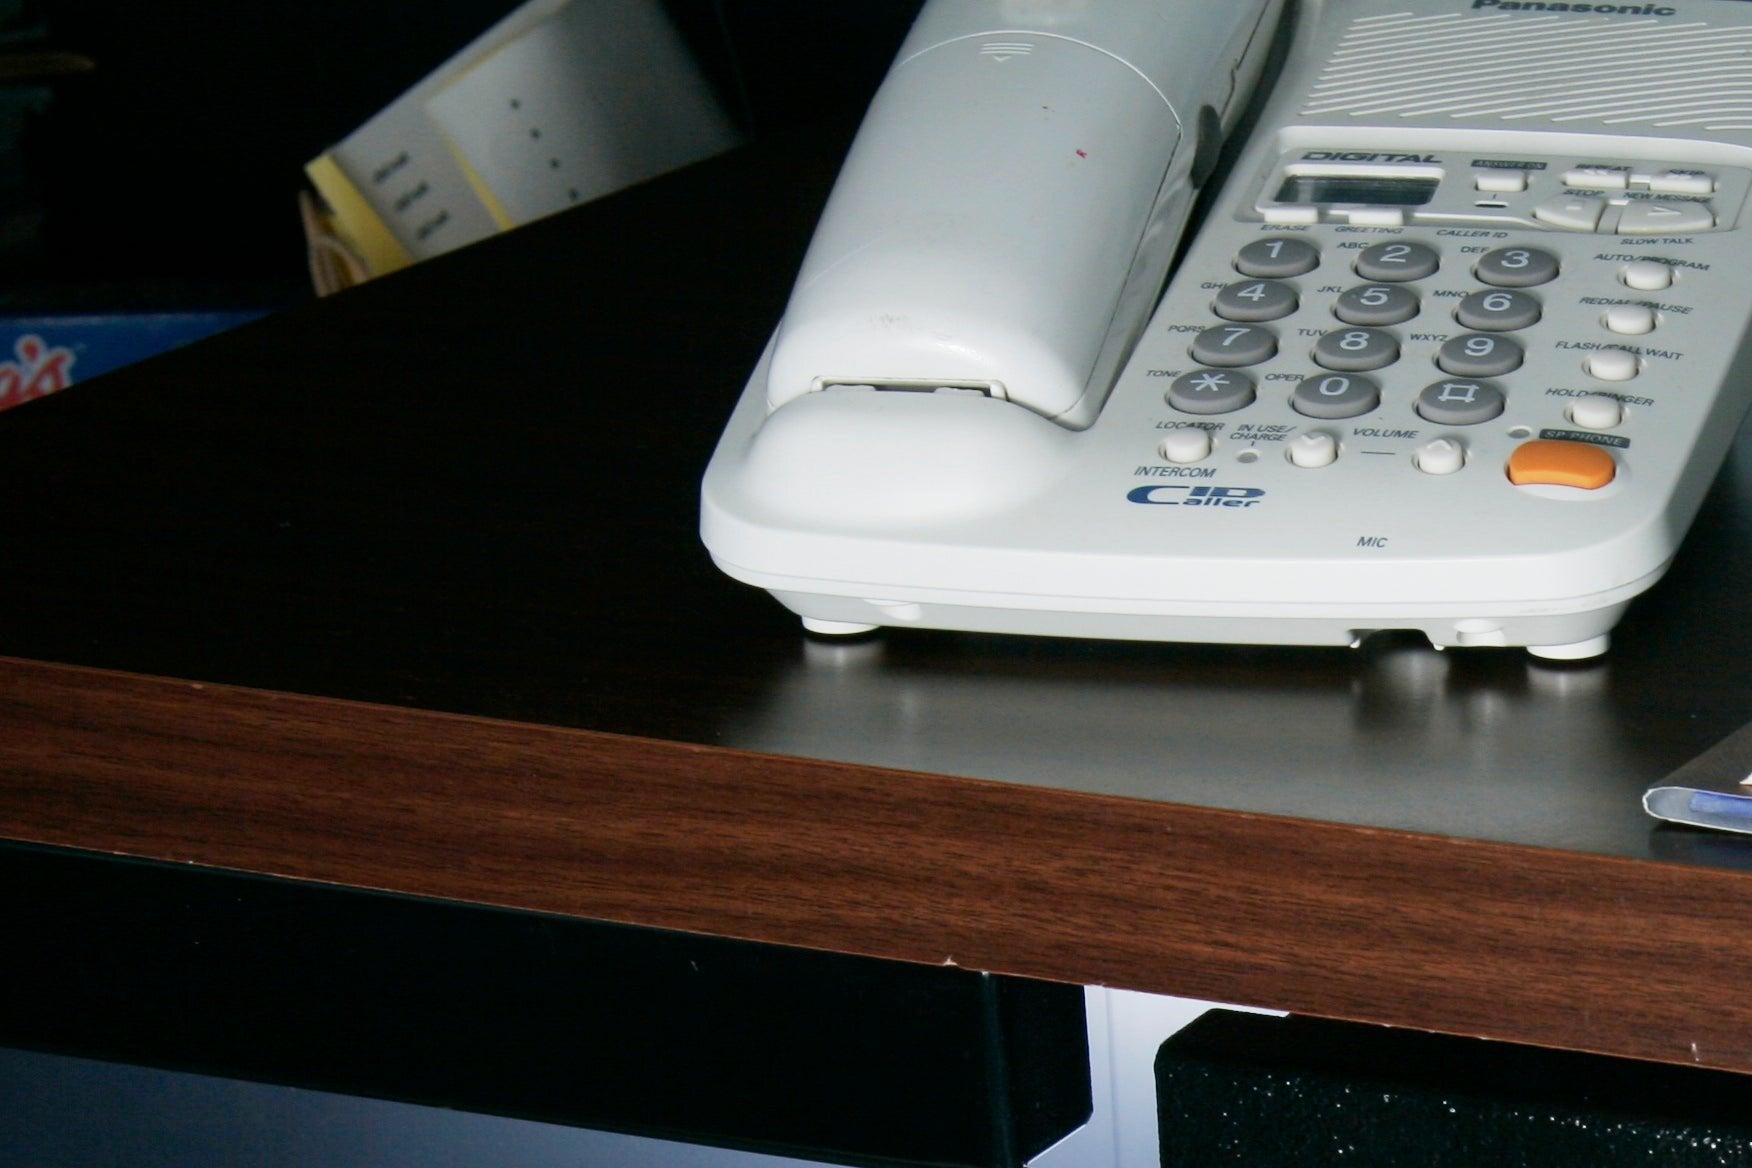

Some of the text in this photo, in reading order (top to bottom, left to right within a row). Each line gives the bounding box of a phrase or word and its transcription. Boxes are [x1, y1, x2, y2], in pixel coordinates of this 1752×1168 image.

[1471, 0, 1677, 16] Panasonic
[1301, 152, 1443, 164] DIGITAL
[1575, 164, 1632, 174] REPEAT
[1563, 189, 1604, 197] STOP
[1623, 191, 1713, 204] NEW MESSAGE
[1260, 224, 1311, 232] ERASE
[1334, 226, 1405, 235] GREETING
[1436, 229, 1509, 239] CALLER ID
[1620, 237, 1694, 246] SLOW TALK
[1265, 240, 1284, 258] 1
[1336, 241, 1412, 264] ABC 2
[1460, 246, 1530, 269] DEF 3
[1593, 252, 1711, 272] AUTO/PROGRAM
[1236, 283, 1266, 302] 4
[1316, 285, 1391, 306] JKL 5
[1432, 289, 1513, 312] MNO 6
[1167, 324, 1251, 347] PQRS 7
[1297, 328, 1371, 351] TUV 8
[1409, 333, 1495, 357] WXYZ 9
[1645, 348, 1685, 361] WAIT
[1145, 370, 1182, 378] TONE
[1264, 373, 1350, 396] OPER 0
[1155, 420, 1226, 431] LOCATOR
[1236, 424, 1298, 433] IN USE/
[1229, 432, 1288, 441] CHARGE
[1352, 428, 1420, 439] VOLUME
[1133, 466, 1218, 478] INTERCOM
[1356, 536, 1389, 548] MIC
